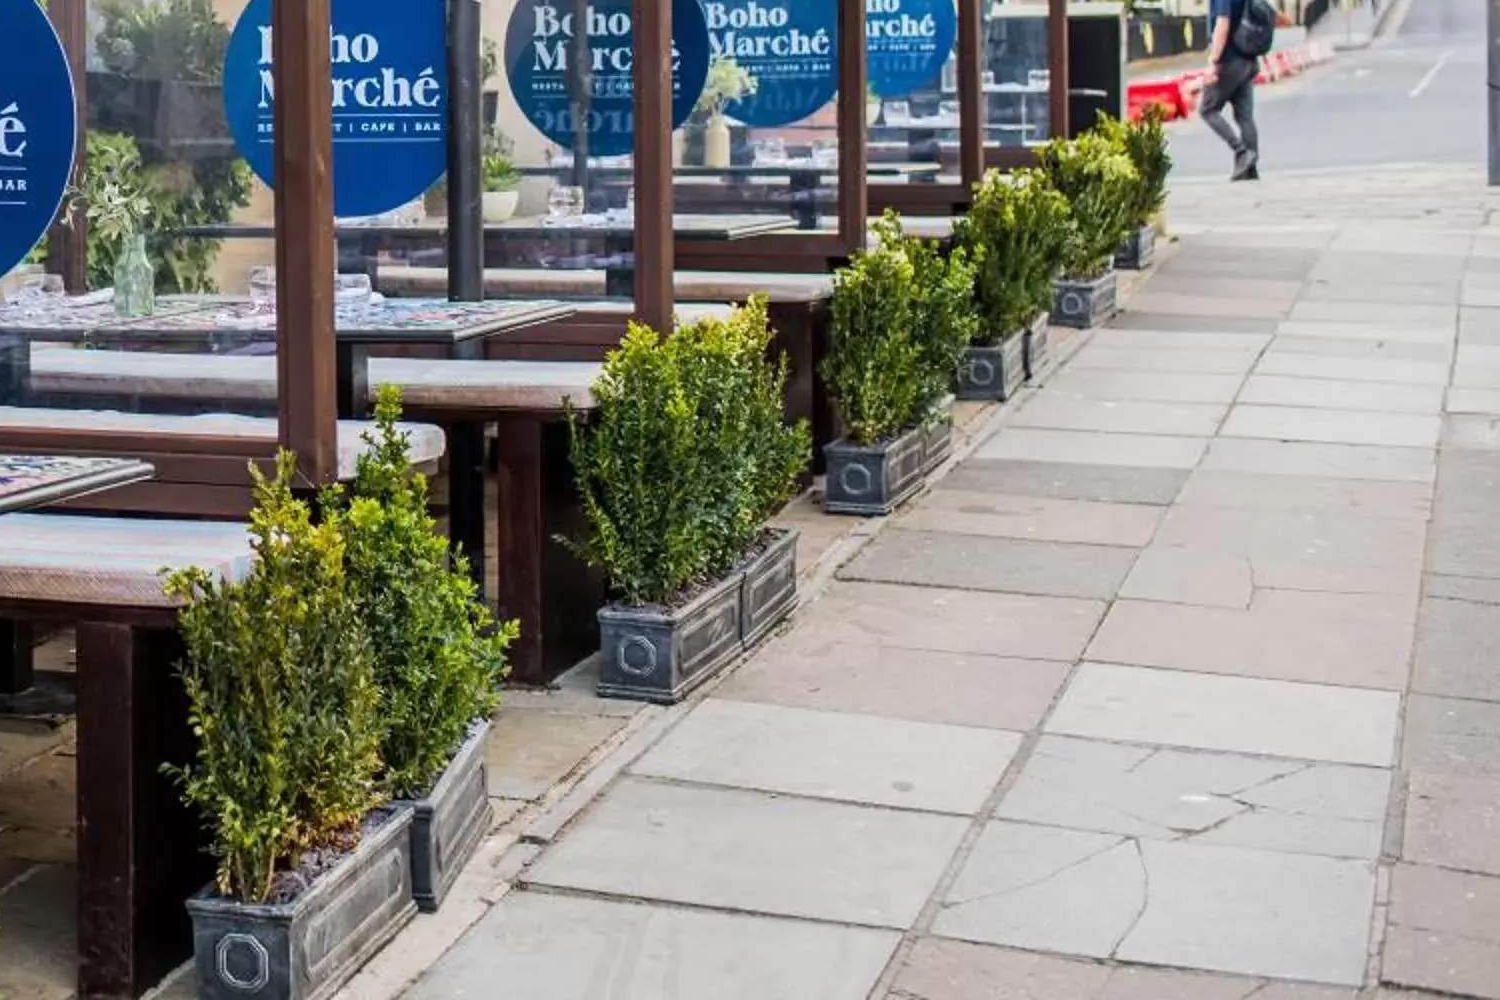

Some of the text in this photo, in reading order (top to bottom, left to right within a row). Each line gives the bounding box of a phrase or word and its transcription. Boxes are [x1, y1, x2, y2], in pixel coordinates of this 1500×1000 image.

[704, 0, 787, 29] Boho
[866, 13, 936, 37] rché
[708, 27, 830, 57] Marché
[257, 65, 441, 108] rché
[361, 122, 442, 132] CAFE BAR
